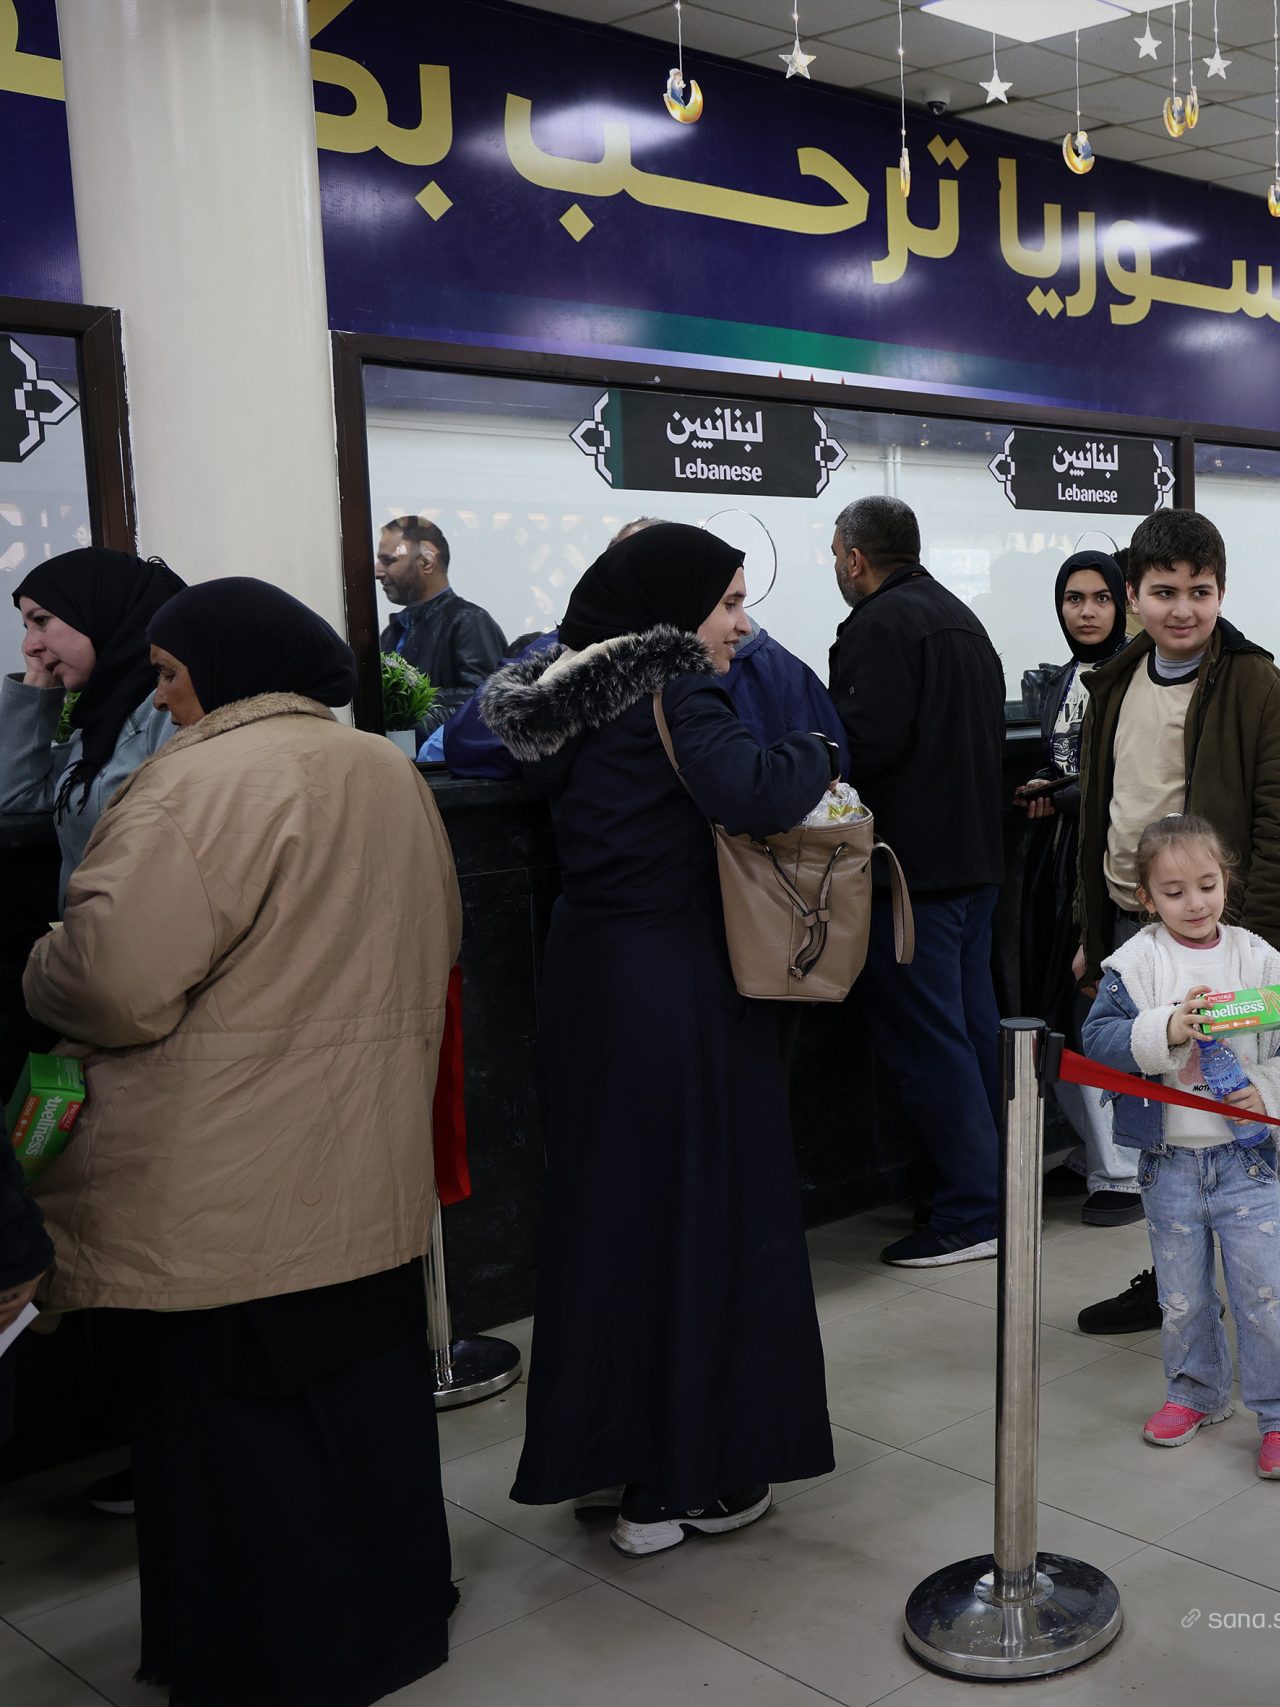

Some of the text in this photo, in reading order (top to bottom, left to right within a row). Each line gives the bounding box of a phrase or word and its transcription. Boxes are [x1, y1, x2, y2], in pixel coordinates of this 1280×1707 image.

[503, 92, 970, 285] ترحب
[666, 406, 764, 453] لبنانيين
[674, 456, 763, 483] Lebanese
[1052, 441, 1119, 479] لبنانيين
[1057, 482, 1118, 504] Lebanese
[25, 1095, 63, 1156] wellness
